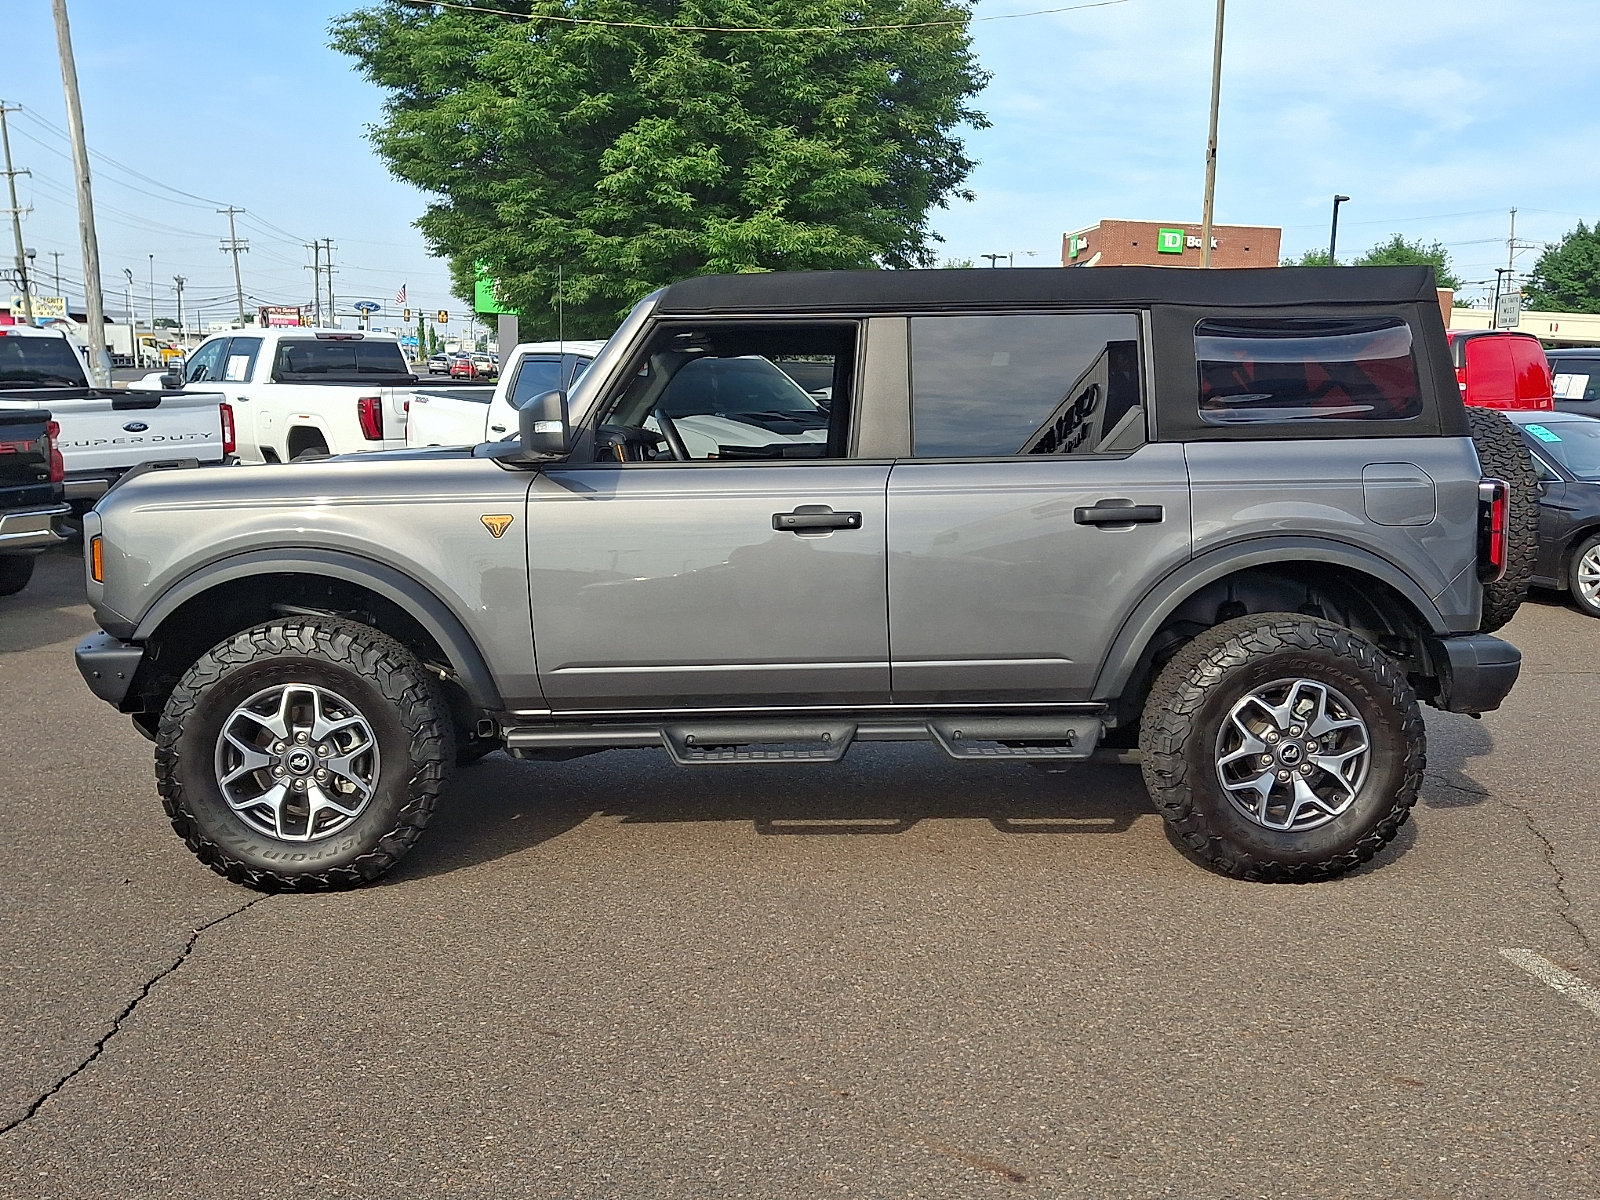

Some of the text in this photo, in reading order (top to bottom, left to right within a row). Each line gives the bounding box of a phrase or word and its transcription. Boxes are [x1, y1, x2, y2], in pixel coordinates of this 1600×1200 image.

[1162, 232, 1218, 248] TD Bak
[57, 431, 213, 449] SUPER DUTY
